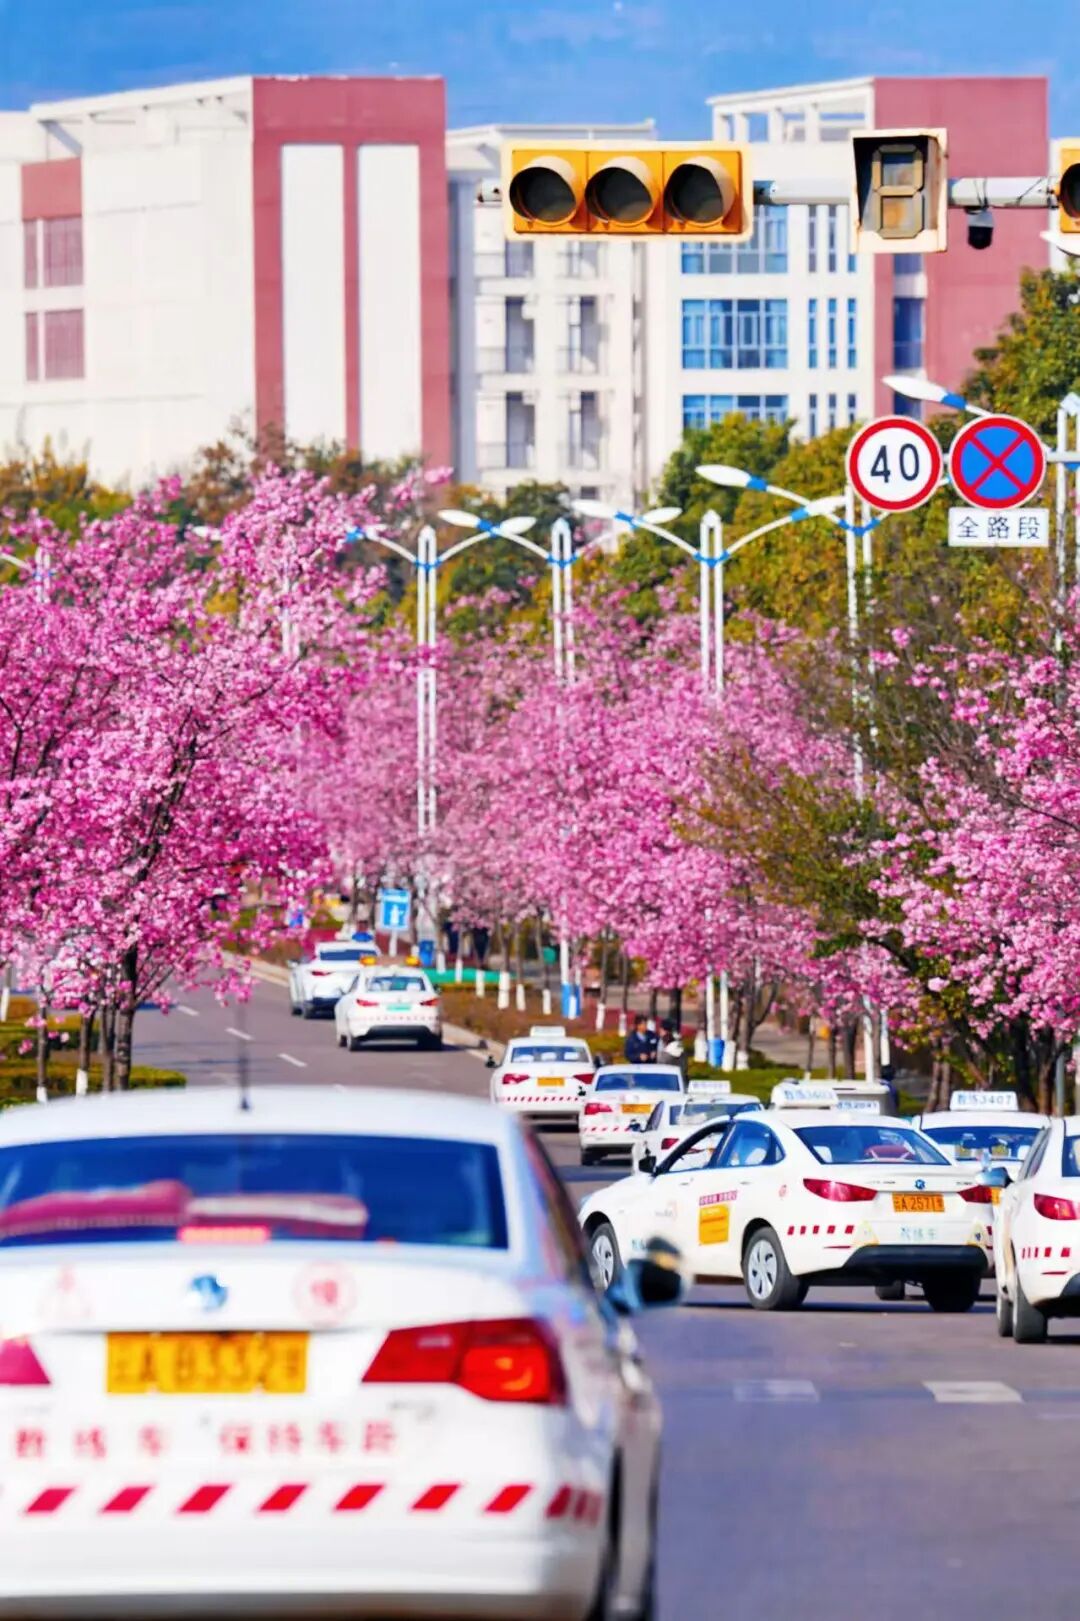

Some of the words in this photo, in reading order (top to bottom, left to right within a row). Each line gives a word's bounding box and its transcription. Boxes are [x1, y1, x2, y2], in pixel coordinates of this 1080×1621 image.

[870, 443, 920, 483] 40
[956, 515, 1041, 540] 全路段
